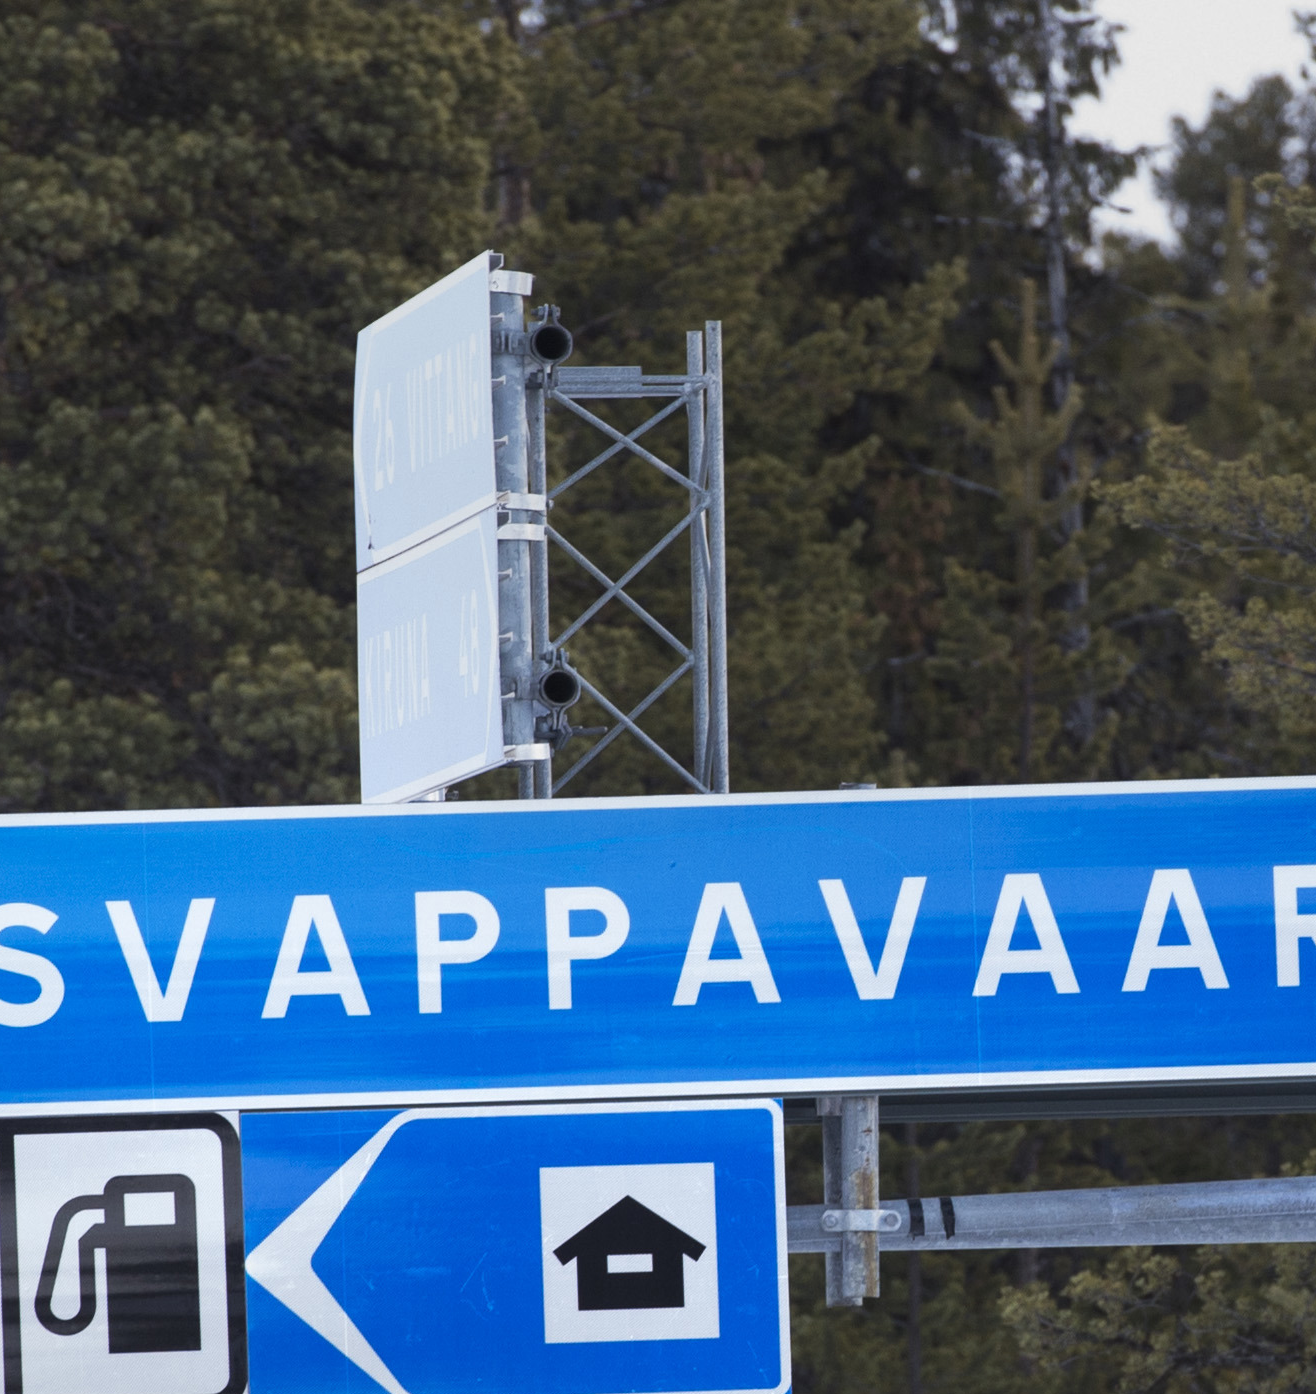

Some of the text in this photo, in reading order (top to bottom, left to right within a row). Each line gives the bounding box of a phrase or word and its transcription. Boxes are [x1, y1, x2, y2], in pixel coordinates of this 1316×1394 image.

[372, 329, 486, 492] 26 VITTANGI
[364, 588, 480, 740] KIRUNA 48
